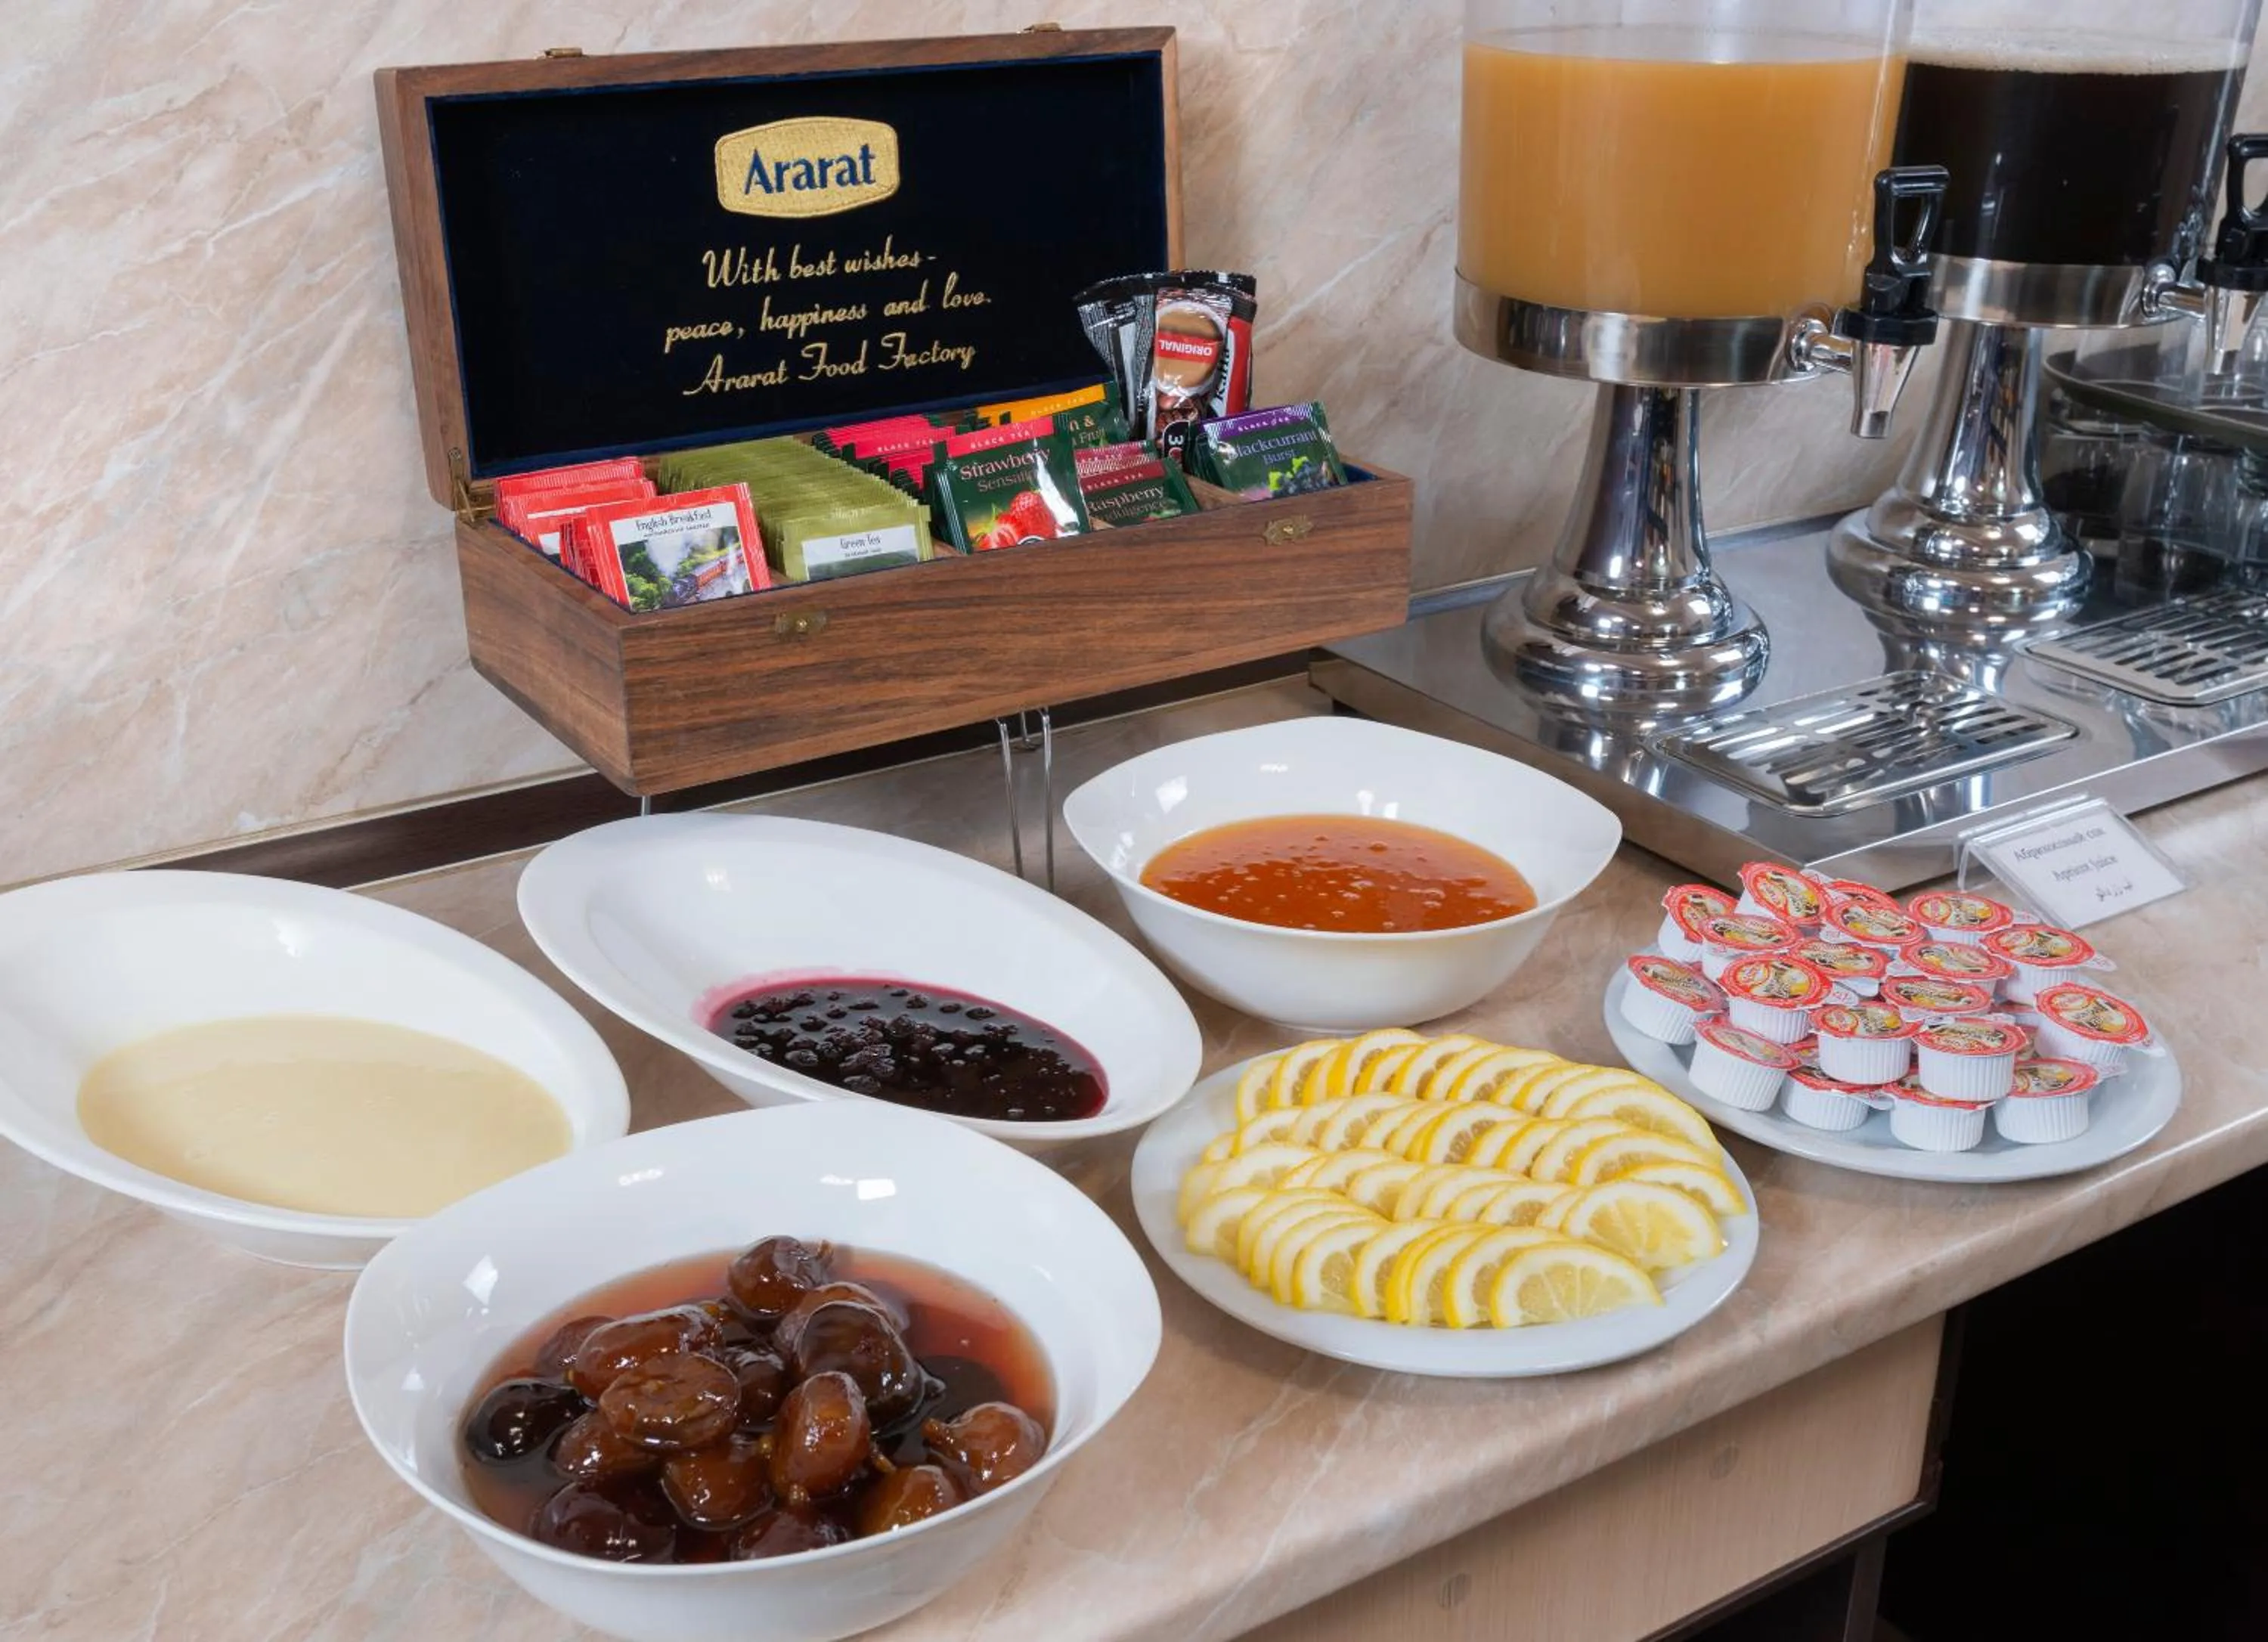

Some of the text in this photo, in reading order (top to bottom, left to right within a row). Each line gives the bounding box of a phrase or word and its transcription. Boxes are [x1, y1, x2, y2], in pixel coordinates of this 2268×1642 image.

[744, 144, 876, 195] Ararat
[702, 245, 781, 289] With
[789, 244, 837, 280] best
[664, 320, 745, 353] peace,
[759, 296, 868, 339] happiness
[883, 278, 931, 318] and
[682, 332, 976, 396] Ararat Food Factory
[1158, 339, 1213, 357] ORIGINAL
[970, 429, 1030, 449] BLACK TEA
[840, 536, 866, 550] Green
